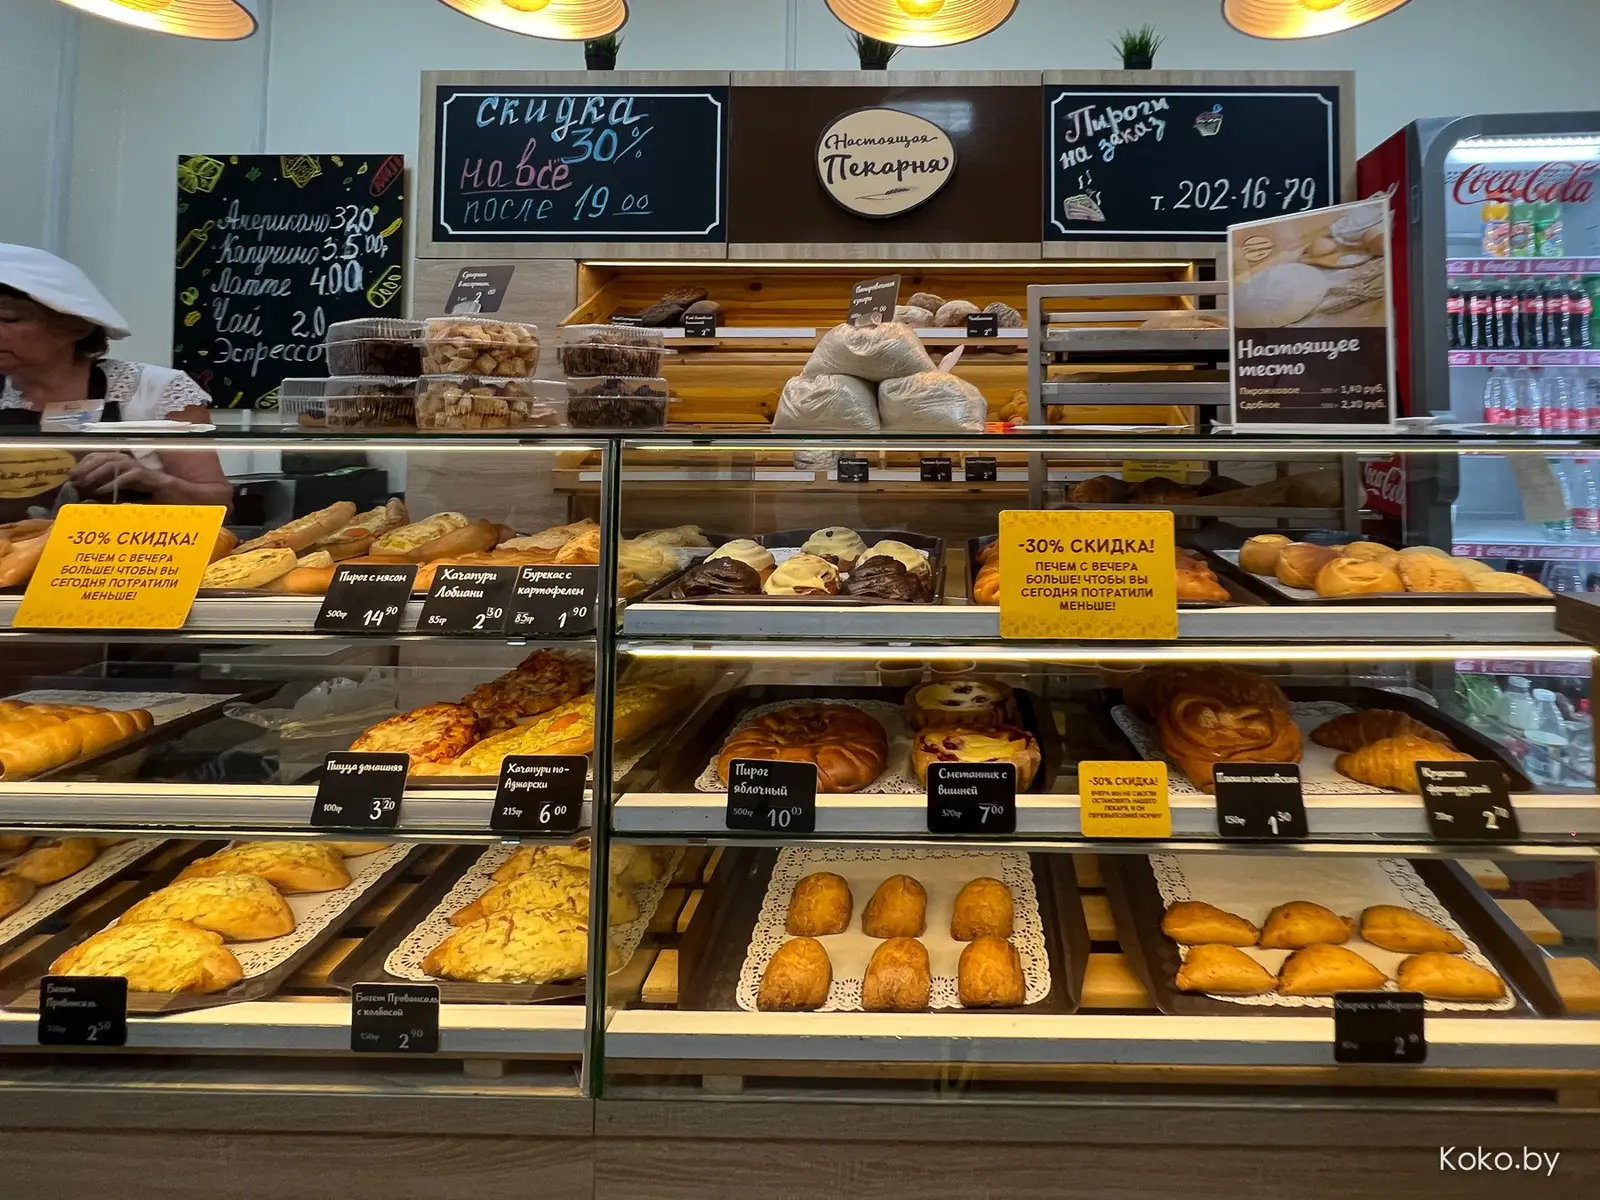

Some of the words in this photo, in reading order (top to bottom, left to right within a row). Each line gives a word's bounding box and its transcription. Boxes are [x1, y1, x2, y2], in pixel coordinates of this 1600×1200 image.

[1063, 97, 1170, 143] Пироги
[824, 132, 938, 150] Настоящая
[1058, 143, 1093, 169] на
[460, 157, 513, 190] на
[823, 153, 949, 185] Пекарня
[1173, 177, 1317, 211] 202-16-79
[463, 197, 553, 224] после
[216, 199, 331, 241] Американо
[210, 267, 292, 297] Латте
[212, 297, 263, 337] Чай
[1238, 339, 1360, 359] Настоящее
[212, 337, 323, 378] Эспрессо
[1239, 363, 1306, 377] тесто
[67, 531, 110, 545] -30%
[116, 531, 199, 547] СКИДКА!
[1018, 539, 1065, 553] -30%
[1070, 538, 1155, 555] СКИДКА!
[75, 553, 115, 562] ПЕЧЕМ
[118, 553, 126, 562] С
[129, 553, 173, 563] ВЕЧЕРА
[60, 565, 114, 575] БОЛЬШЕ!
[116, 566, 157, 575] ЧТОБЫ
[160, 566, 179, 575] ВЫ
[1035, 562, 1076, 571] ПЕЧЕМ
[1080, 562, 1089, 571] С
[1091, 562, 1138, 571] ВЕЧЕРА
[339, 571, 367, 584] Пирог
[375, 573, 407, 582] мясом
[440, 568, 498, 584] Хачапури
[522, 568, 562, 583] Бурекас
[1026, 575, 1081, 584] БОЛЬШЕ!
[1083, 575, 1126, 584] ЧТОБЫ
[1129, 575, 1148, 584] ВЫ
[51, 578, 106, 589] СЕГОДНЯ
[108, 578, 178, 588] ПОТРАТИЛИ
[81, 591, 137, 600] МЕНЬШЕ!
[434, 586, 484, 598] Лобиани
[517, 585, 584, 599] картофелем
[1021, 588, 1078, 598] СЕГОДНЯ
[1081, 588, 1153, 597] ПОТРАТИЛИ
[1059, 601, 1116, 610] МЕНЬШЕ!
[326, 609, 348, 619] 500гр
[428, 615, 447, 625] 85гр
[326, 760, 358, 774] Пицца
[358, 764, 403, 774] домашняя
[507, 763, 552, 777] Хачапури
[552, 766, 570, 774] по-
[735, 763, 769, 779] Пирог
[938, 767, 1000, 779] Сметанник
[1001, 771, 1008, 779] с
[504, 777, 548, 792] Аджарски
[733, 781, 788, 796] яблочный
[1089, 777, 1113, 786] -30%
[1115, 777, 1158, 787] СКИДКА!
[938, 784, 978, 795] вишней
[363, 1007, 404, 1016] колбасой
